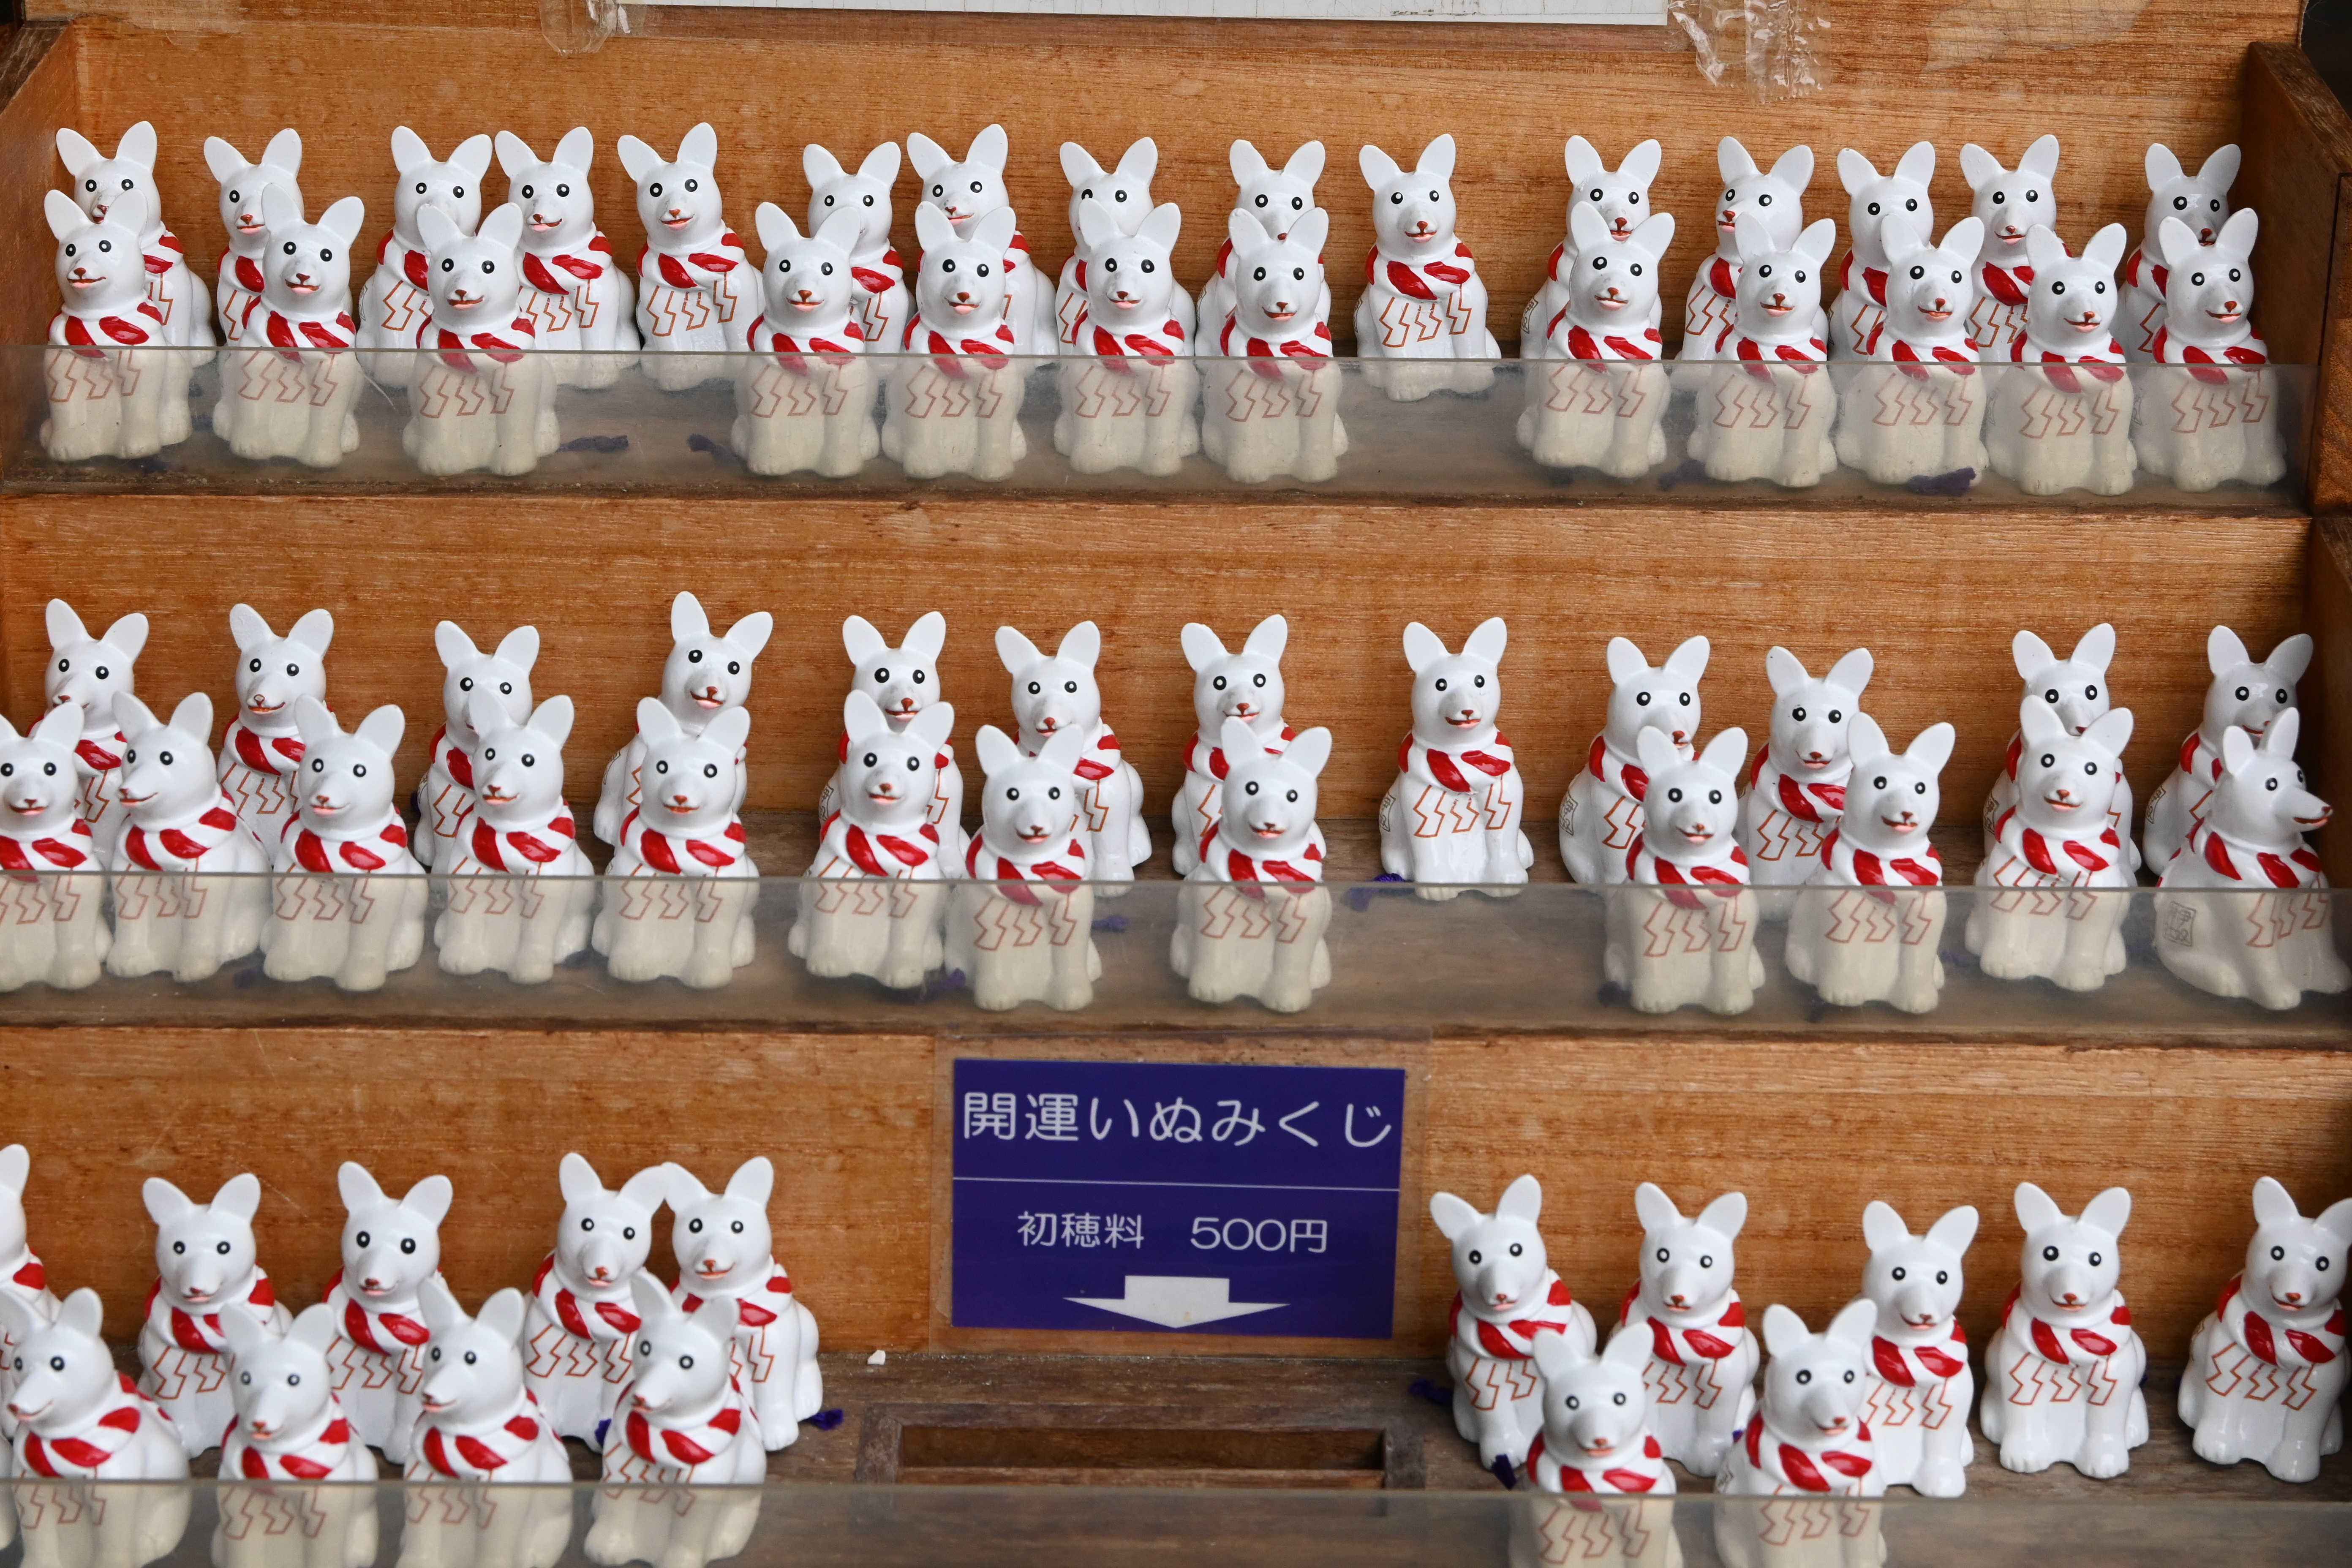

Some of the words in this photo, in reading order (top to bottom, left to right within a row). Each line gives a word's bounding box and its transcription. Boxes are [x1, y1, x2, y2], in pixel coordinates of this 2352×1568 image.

[964, 1092, 1392, 1148] 開運いぬみくじ
[1017, 1211, 1144, 1249] 初穂料
[1190, 1217, 1328, 1253] 500円
